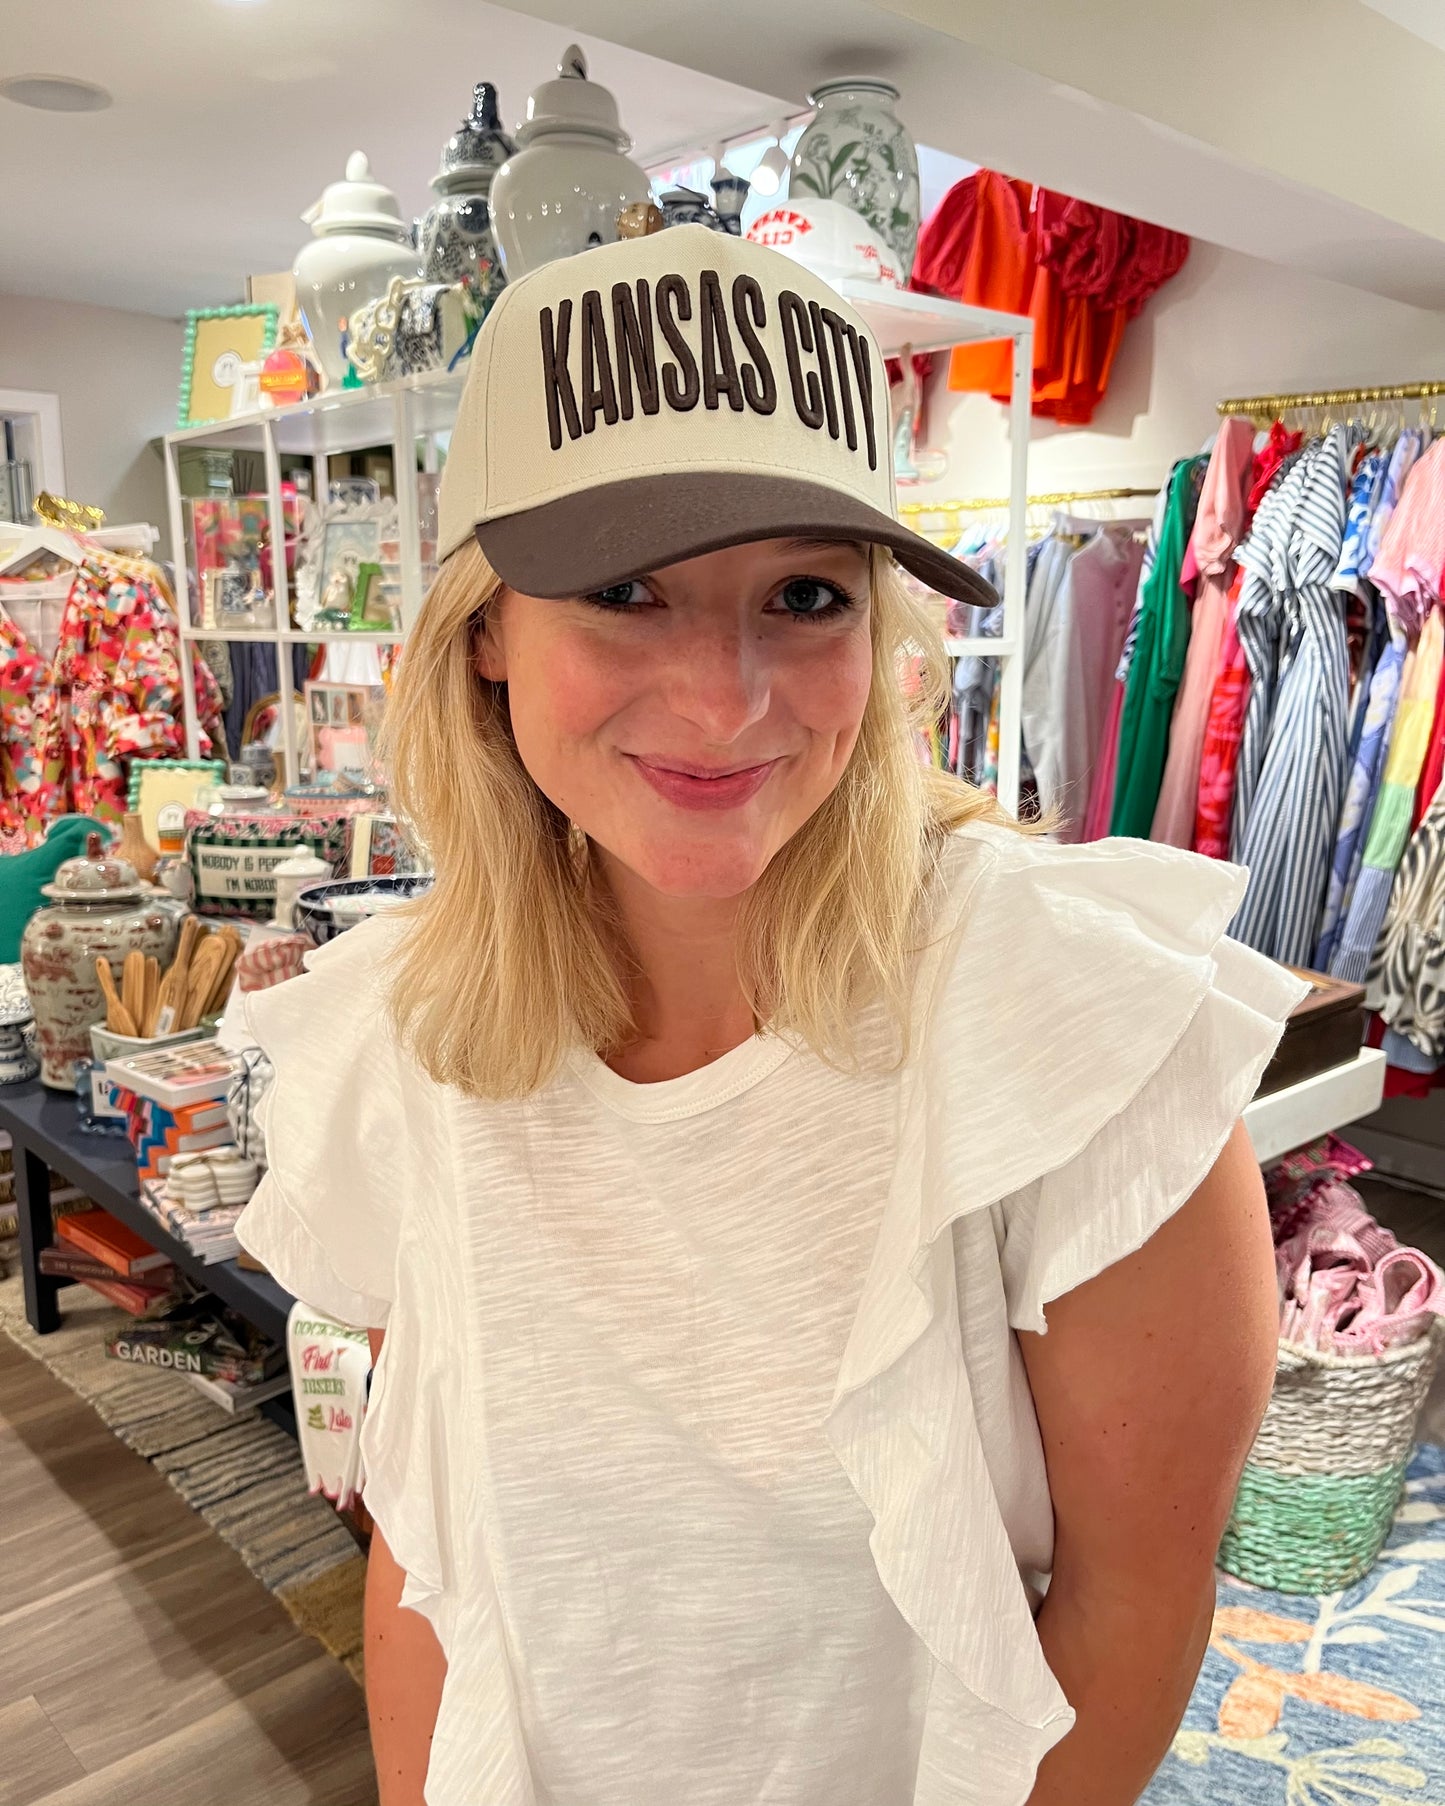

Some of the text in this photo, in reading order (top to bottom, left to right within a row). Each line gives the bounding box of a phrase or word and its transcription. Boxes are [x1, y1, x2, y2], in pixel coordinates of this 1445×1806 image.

[754, 231, 794, 245] CIT
[539, 270, 877, 471] KANSAS CITY
[201, 855, 240, 871] NOBODY
[244, 856, 254, 872] IS
[225, 878, 278, 892] I'M NOBOD
[116, 1341, 201, 1372] GARDEN
